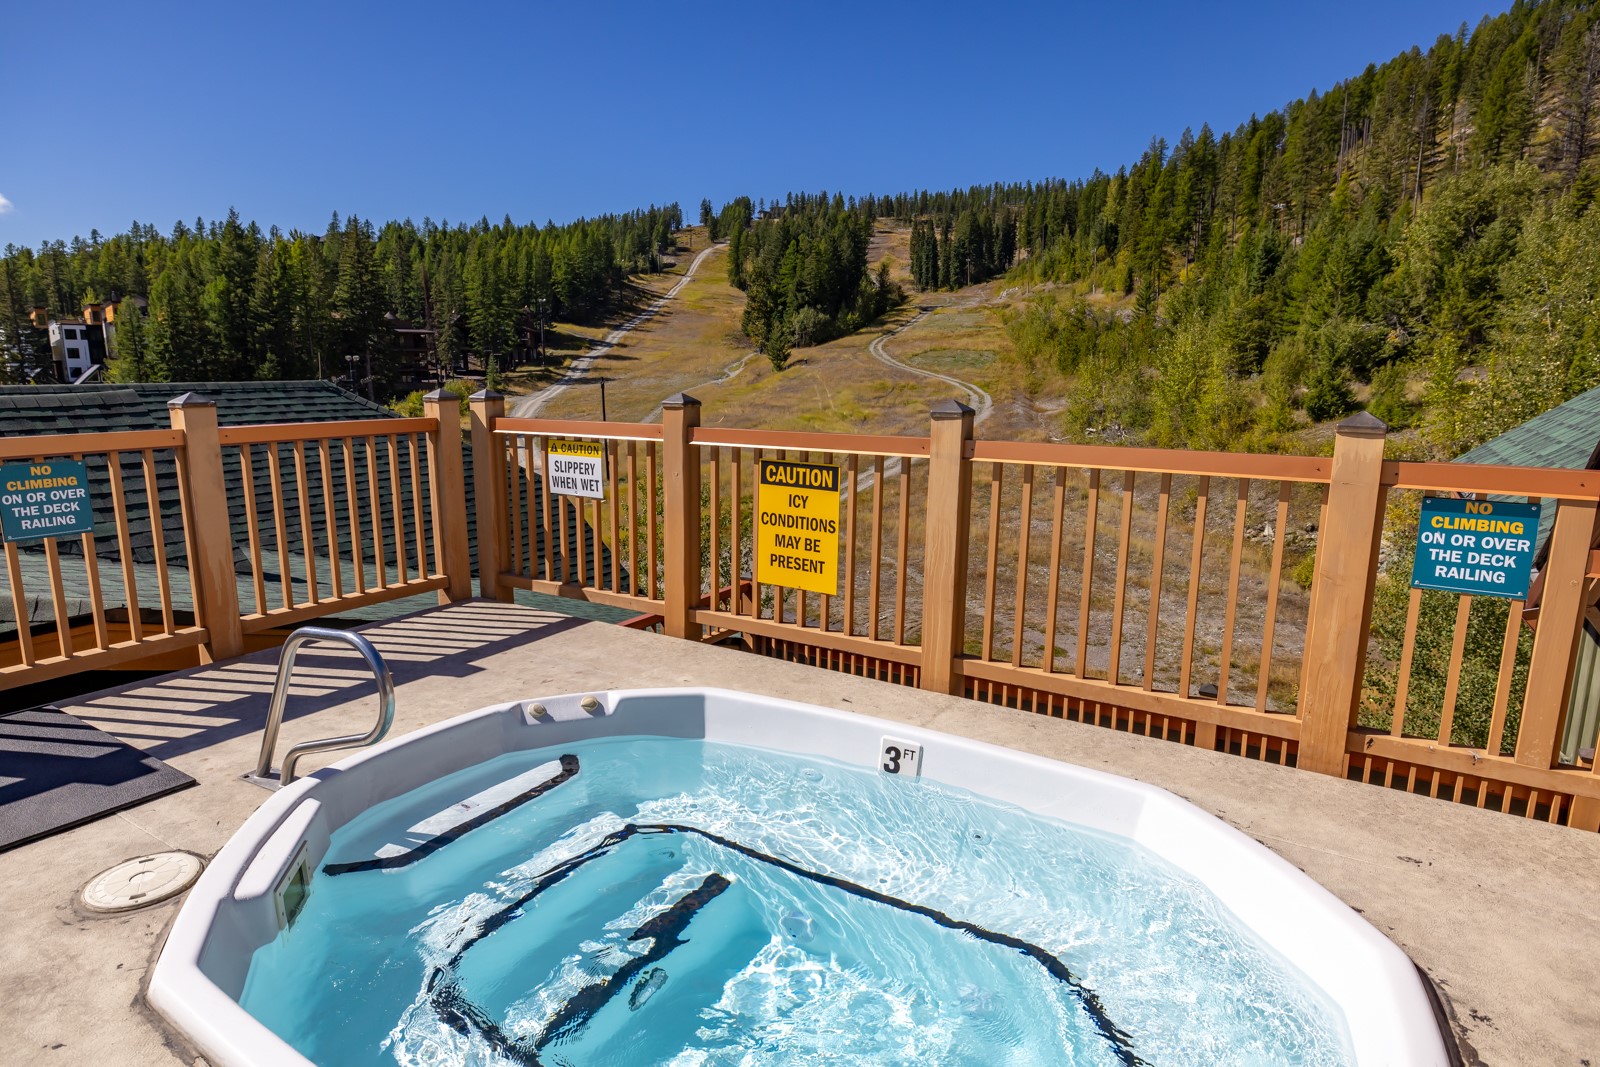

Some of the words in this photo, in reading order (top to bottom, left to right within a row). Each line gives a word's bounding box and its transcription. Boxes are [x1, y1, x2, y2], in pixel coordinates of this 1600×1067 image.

[561, 444, 599, 455] CAUTION
[30, 466, 51, 476] NO
[554, 460, 595, 475] SLIPPERY
[7, 476, 78, 491] CLIMBING
[552, 476, 577, 489] WHEN
[581, 479, 599, 492] WET
[766, 465, 832, 488] CAUTION
[2, 494, 22, 505] ON
[26, 492, 46, 502] OR
[51, 488, 85, 500] OVER
[788, 494, 808, 509] ICY
[12, 506, 39, 517] THE
[43, 502, 80, 514] DECK
[1465, 502, 1493, 514] NO
[21, 515, 76, 530] RAILING
[761, 512, 836, 534] CONDITIONS
[1431, 516, 1524, 534] CLIMBING
[775, 534, 801, 550] MAY
[804, 538, 820, 553] BE
[1421, 532, 1445, 545] ON
[1450, 534, 1476, 548] OR
[1481, 537, 1530, 552] OVER
[770, 554, 825, 574] PRESENT
[1429, 548, 1462, 563] THE
[1467, 552, 1516, 568] DECK
[1435, 566, 1506, 584] RAILING
[884, 746, 901, 774] 3
[903, 749, 916, 760] FT
